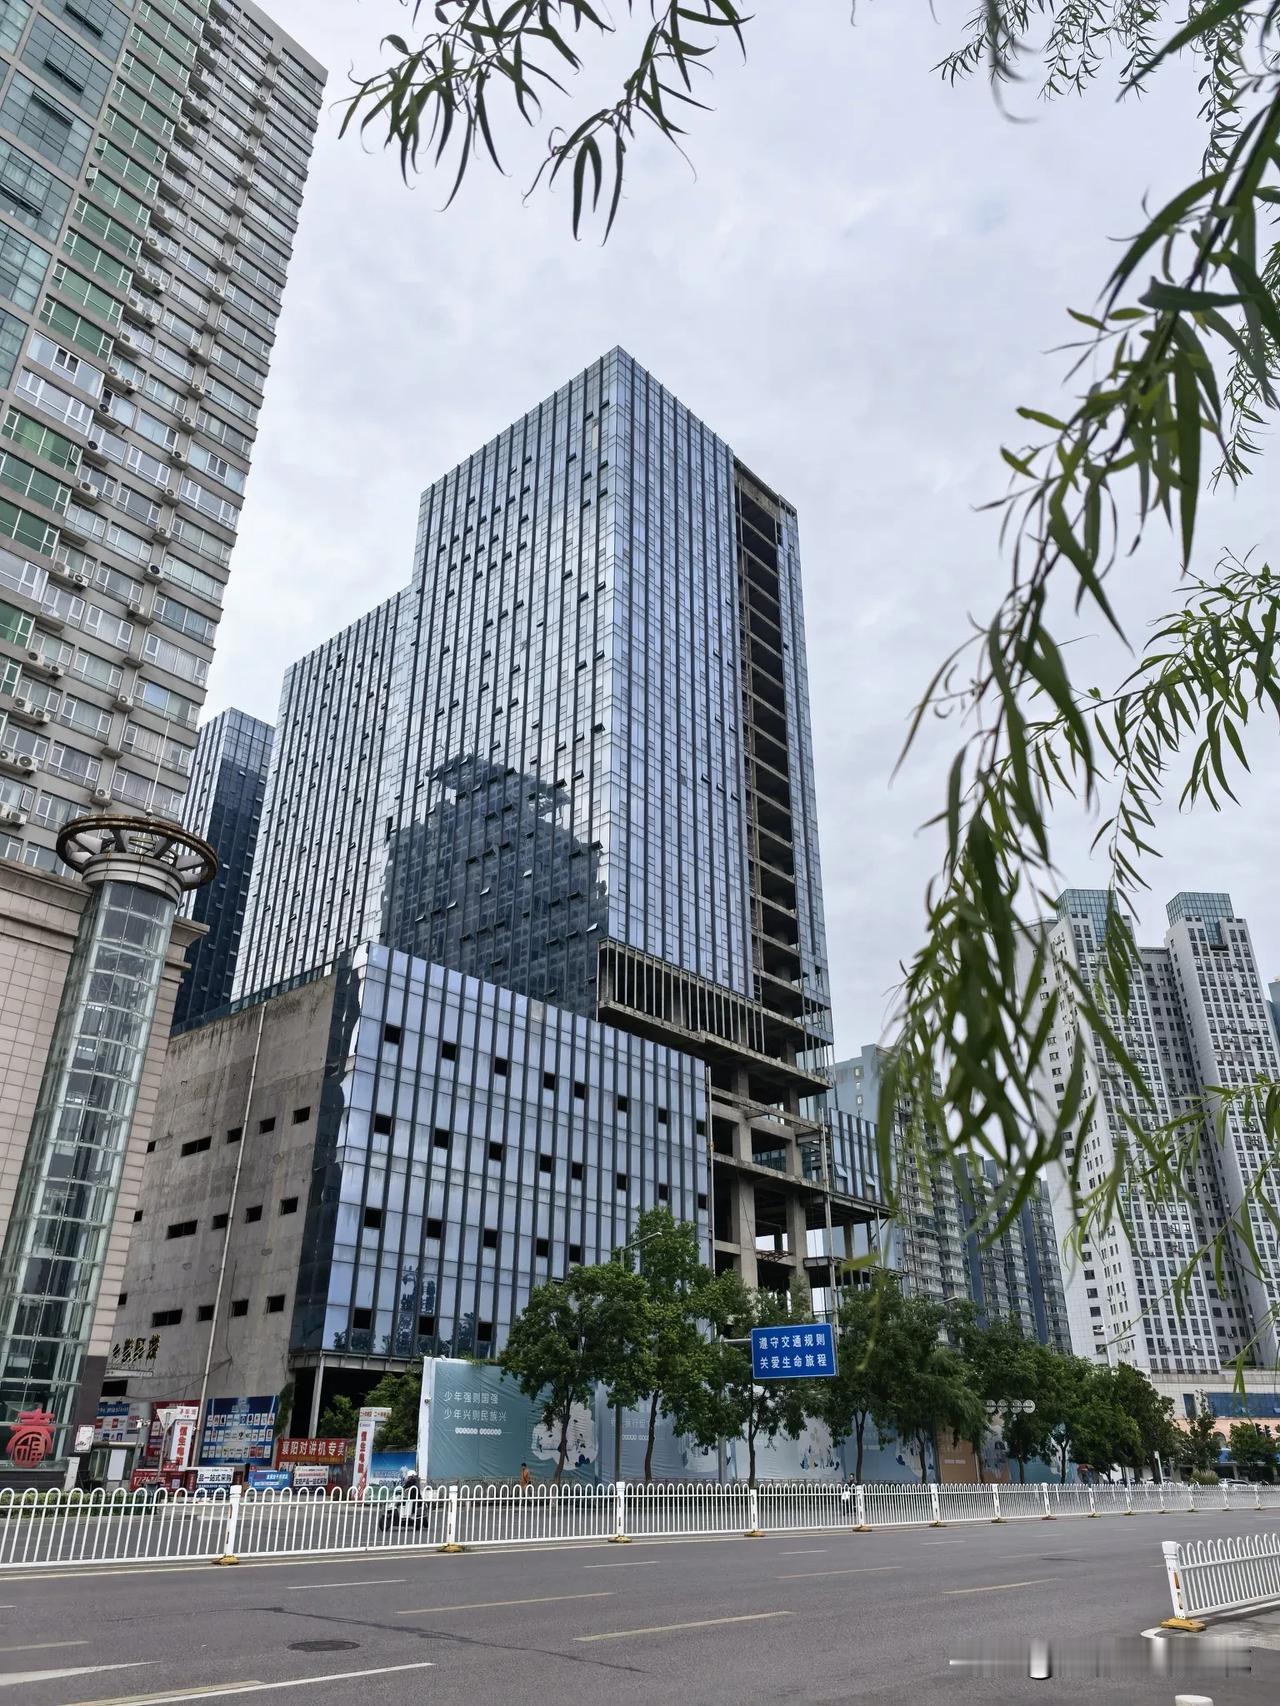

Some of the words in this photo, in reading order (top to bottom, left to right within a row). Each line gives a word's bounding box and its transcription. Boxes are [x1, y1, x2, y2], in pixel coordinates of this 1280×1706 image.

[759, 1333, 826, 1350] 遵守交通规则
[760, 1353, 827, 1369] 关爱生命旅程
[444, 1391, 499, 1404] 少年强则国强
[443, 1407, 507, 1422] 少年兴则民族兴
[281, 1440, 345, 1456] 襄阳对讲机专卖
